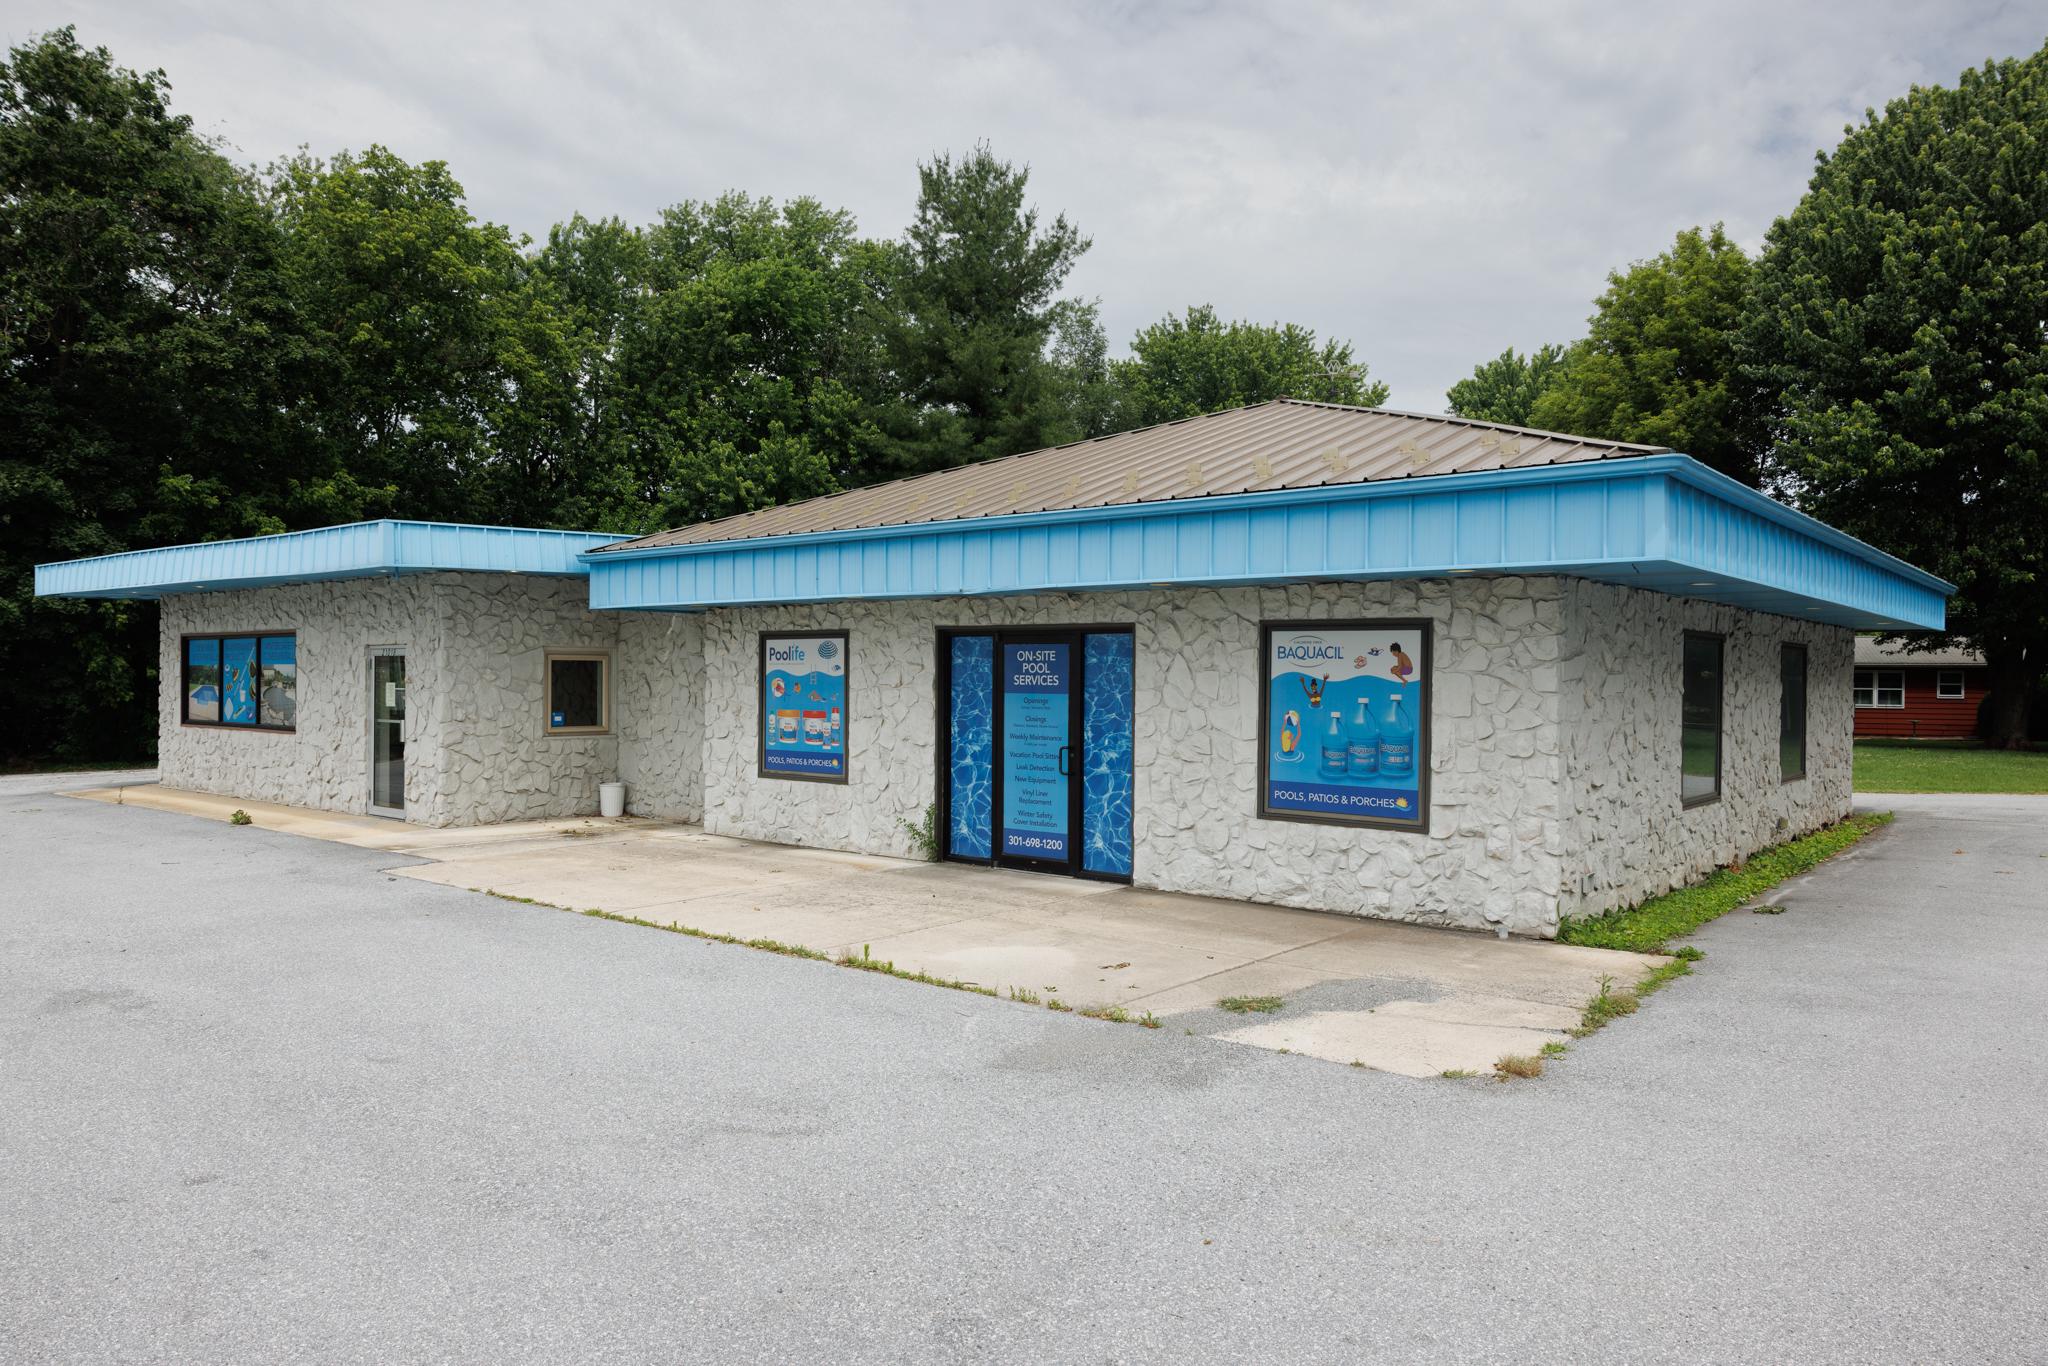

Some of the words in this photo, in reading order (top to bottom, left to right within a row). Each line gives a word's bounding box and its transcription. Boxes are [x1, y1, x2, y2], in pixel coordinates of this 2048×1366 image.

[769, 645, 805, 661] Poolife
[1016, 650, 1056, 662] ON-SITE
[1277, 645, 1343, 660] BAQUACIL
[1022, 663, 1050, 674] POOL
[1013, 675, 1059, 686] SERVICES
[1023, 697, 1048, 706] Openings
[1025, 715, 1047, 724] Closings
[1009, 732, 1029, 741] Weekly
[1029, 733, 1062, 741] Maintenance
[768, 756, 786, 765] POOLS,
[786, 757, 803, 766] PATIOS
[803, 758, 808, 766] &
[808, 758, 832, 768] PORCHES
[1029, 764, 1055, 772] Detection
[1028, 776, 1056, 784] Equipment
[1022, 789, 1034, 797] Vinyl
[1035, 789, 1048, 797] Liner
[1018, 797, 1052, 806] Replacement
[1274, 789, 1306, 802] POOLS,
[1308, 792, 1339, 804] PATIOS
[1341, 794, 1348, 804] &
[1350, 795, 1395, 808] PORCHES
[1017, 810, 1035, 818] Winter
[1036, 811, 1053, 820] Safety
[1029, 819, 1058, 828] Installation
[1008, 835, 1063, 851] 301-698-1200
